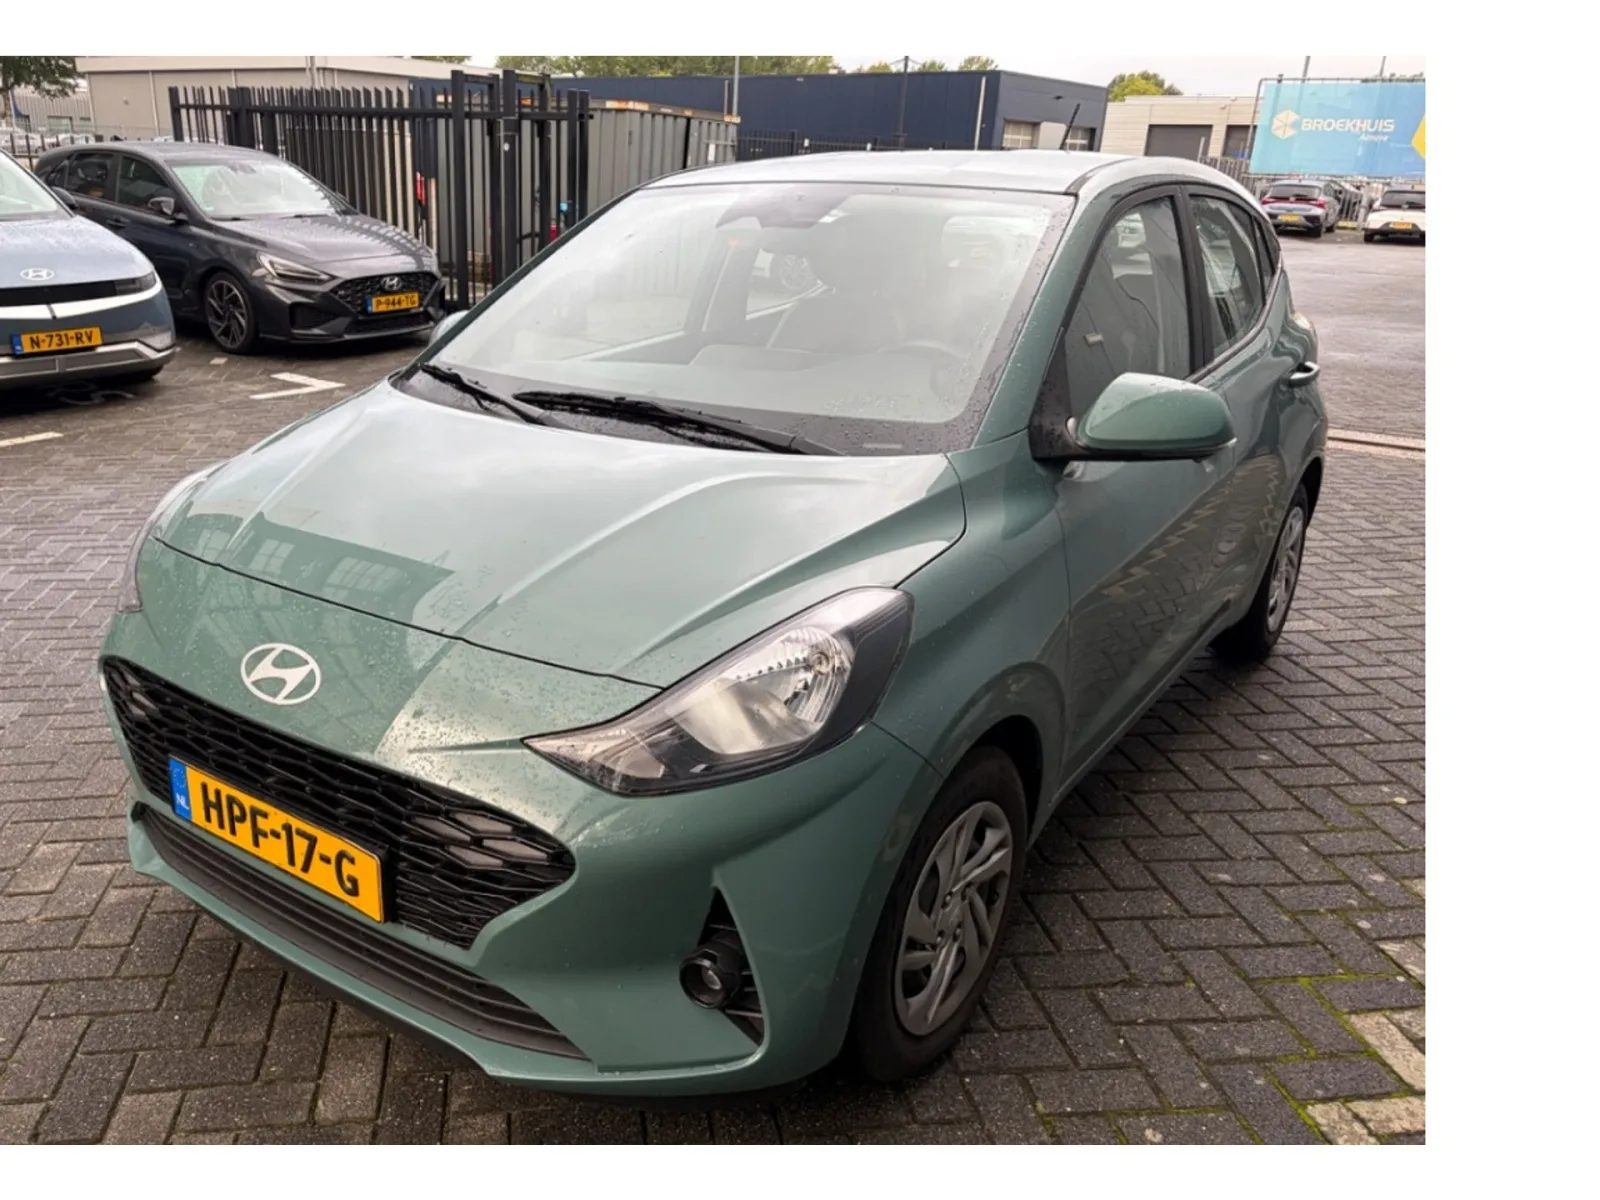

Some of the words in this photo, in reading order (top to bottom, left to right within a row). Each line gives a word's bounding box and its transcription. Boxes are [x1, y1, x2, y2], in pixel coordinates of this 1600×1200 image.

[1301, 118, 1396, 132] BROEKHUIS
[375, 294, 417, 310] P-944-TG
[29, 329, 94, 350] N-731-RV
[175, 793, 189, 811] NL
[200, 781, 360, 898] HPF-17-G
